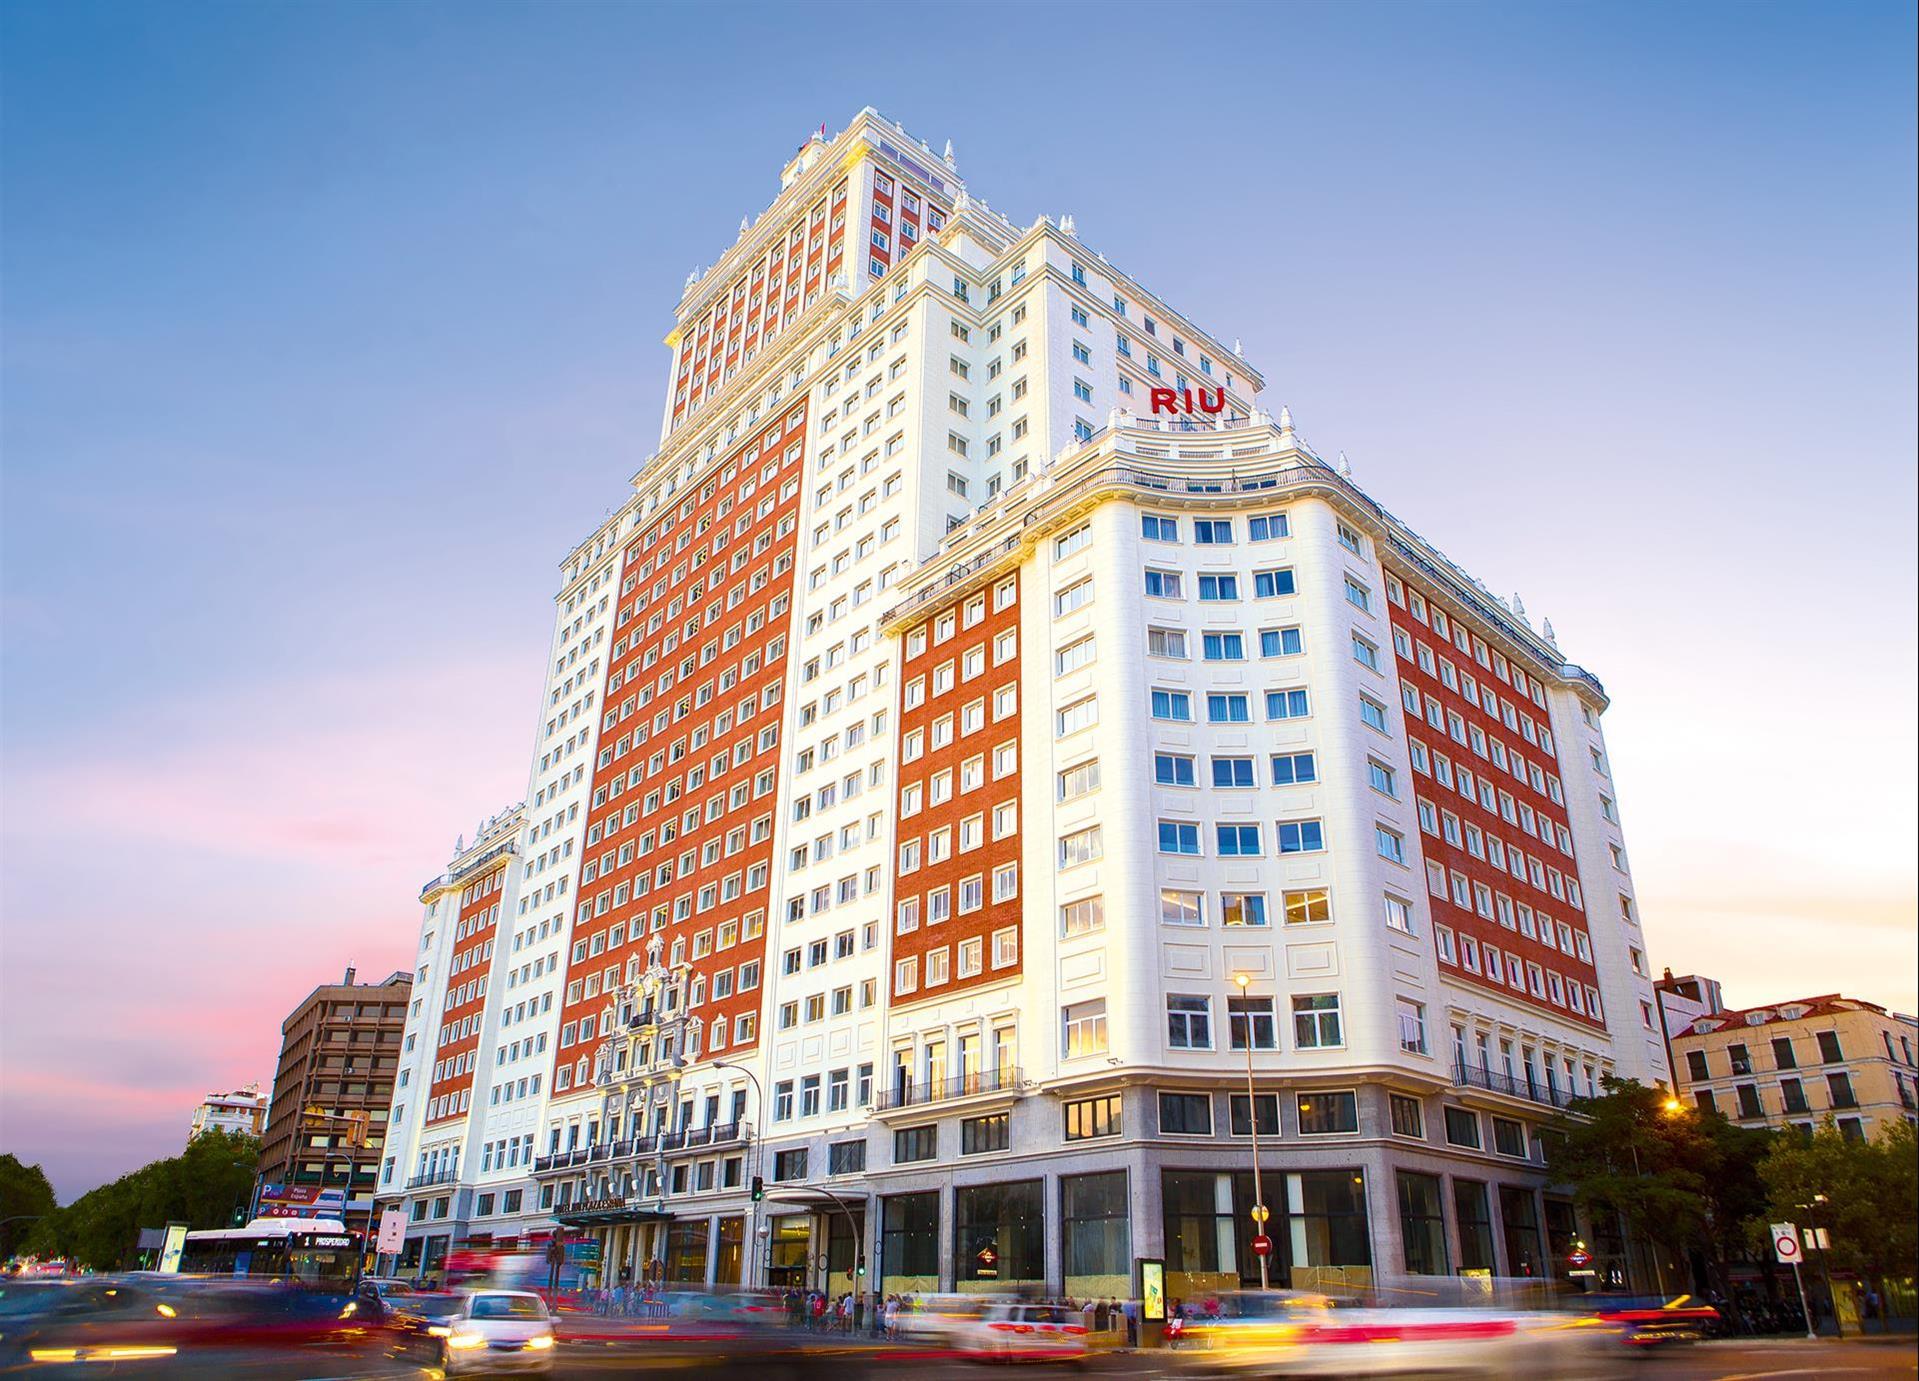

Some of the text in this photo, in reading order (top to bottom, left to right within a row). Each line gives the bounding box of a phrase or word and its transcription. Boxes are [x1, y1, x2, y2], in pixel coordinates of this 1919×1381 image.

[1150, 387, 1226, 415] RIU
[304, 1236, 350, 1246] 1 PROSPERIDAD
